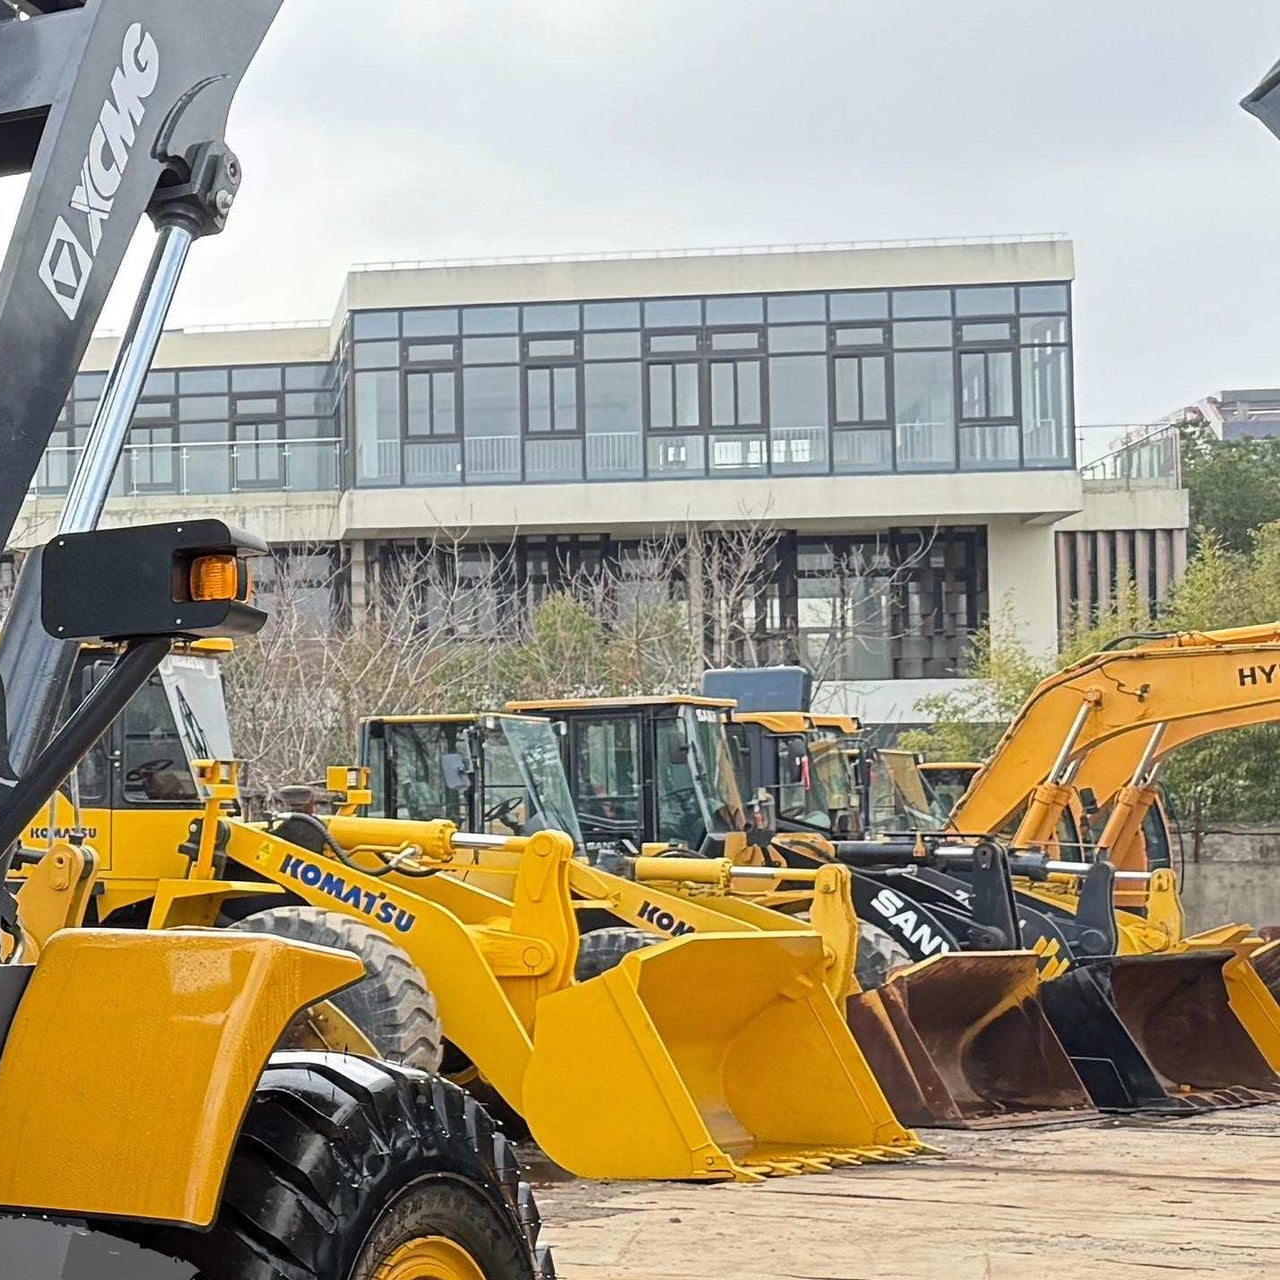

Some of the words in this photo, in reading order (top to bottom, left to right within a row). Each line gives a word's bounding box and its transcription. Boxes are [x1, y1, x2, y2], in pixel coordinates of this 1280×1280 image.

[70, 22, 160, 257] XCMG
[279, 853, 416, 933] KOMATSU
[870, 888, 951, 956] SAN
